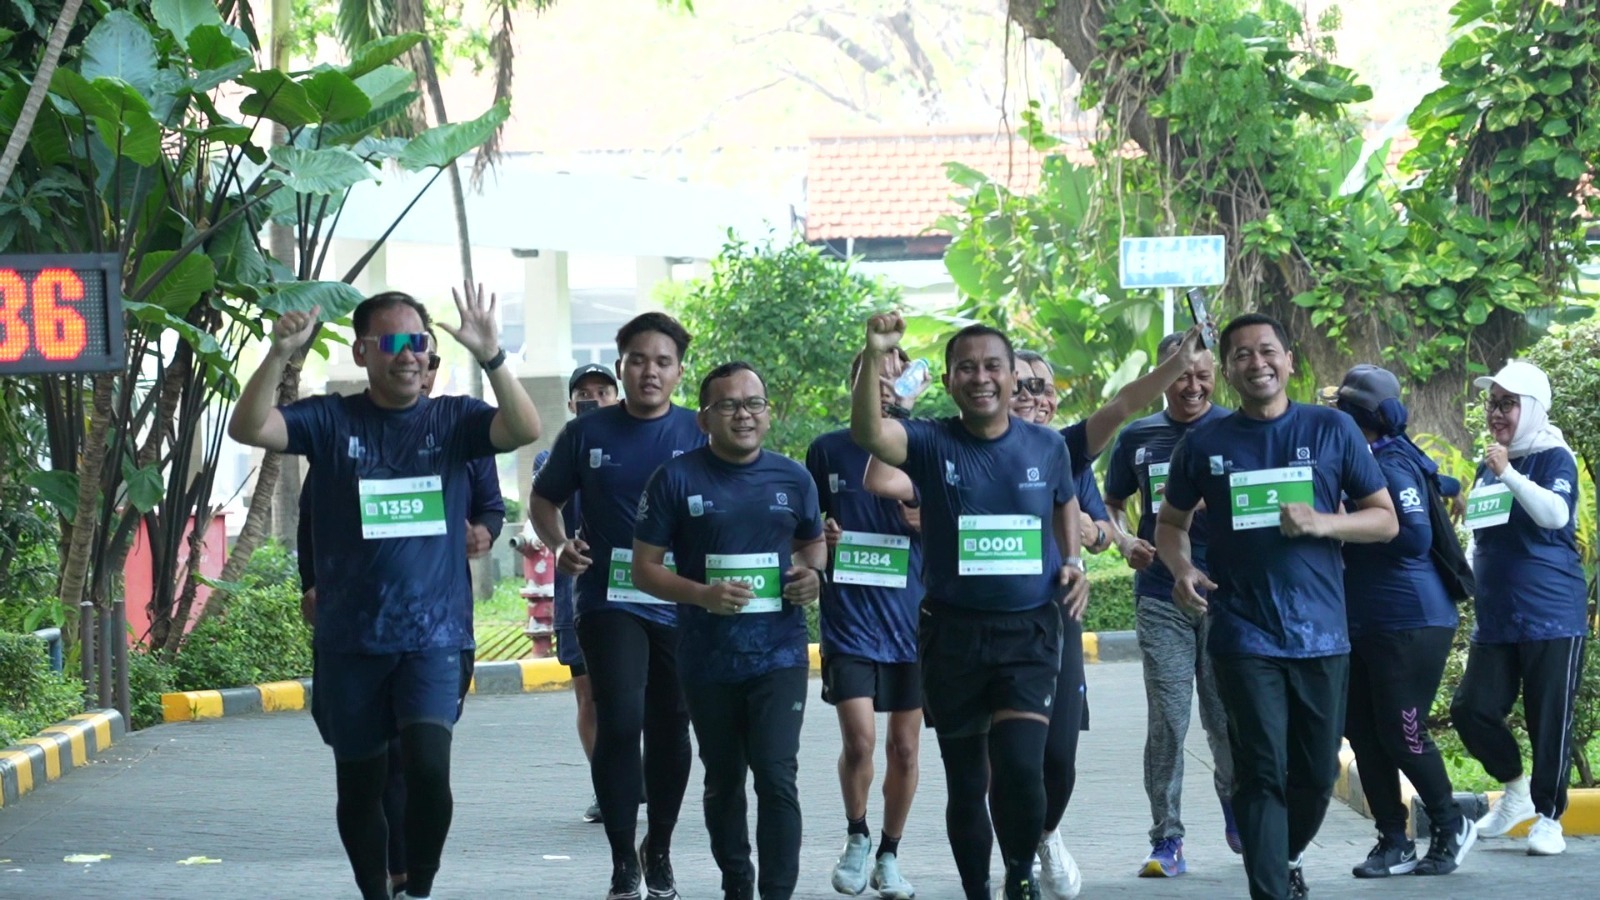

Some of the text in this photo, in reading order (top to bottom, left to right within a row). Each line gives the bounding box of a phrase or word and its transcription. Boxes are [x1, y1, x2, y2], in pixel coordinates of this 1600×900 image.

[1266, 490, 1279, 504] 2
[1399, 487, 1421, 507] 58
[379, 499, 424, 515] 1359
[1478, 498, 1501, 512] 1371
[978, 537, 1024, 551] 0001
[853, 551, 891, 566] 1284
